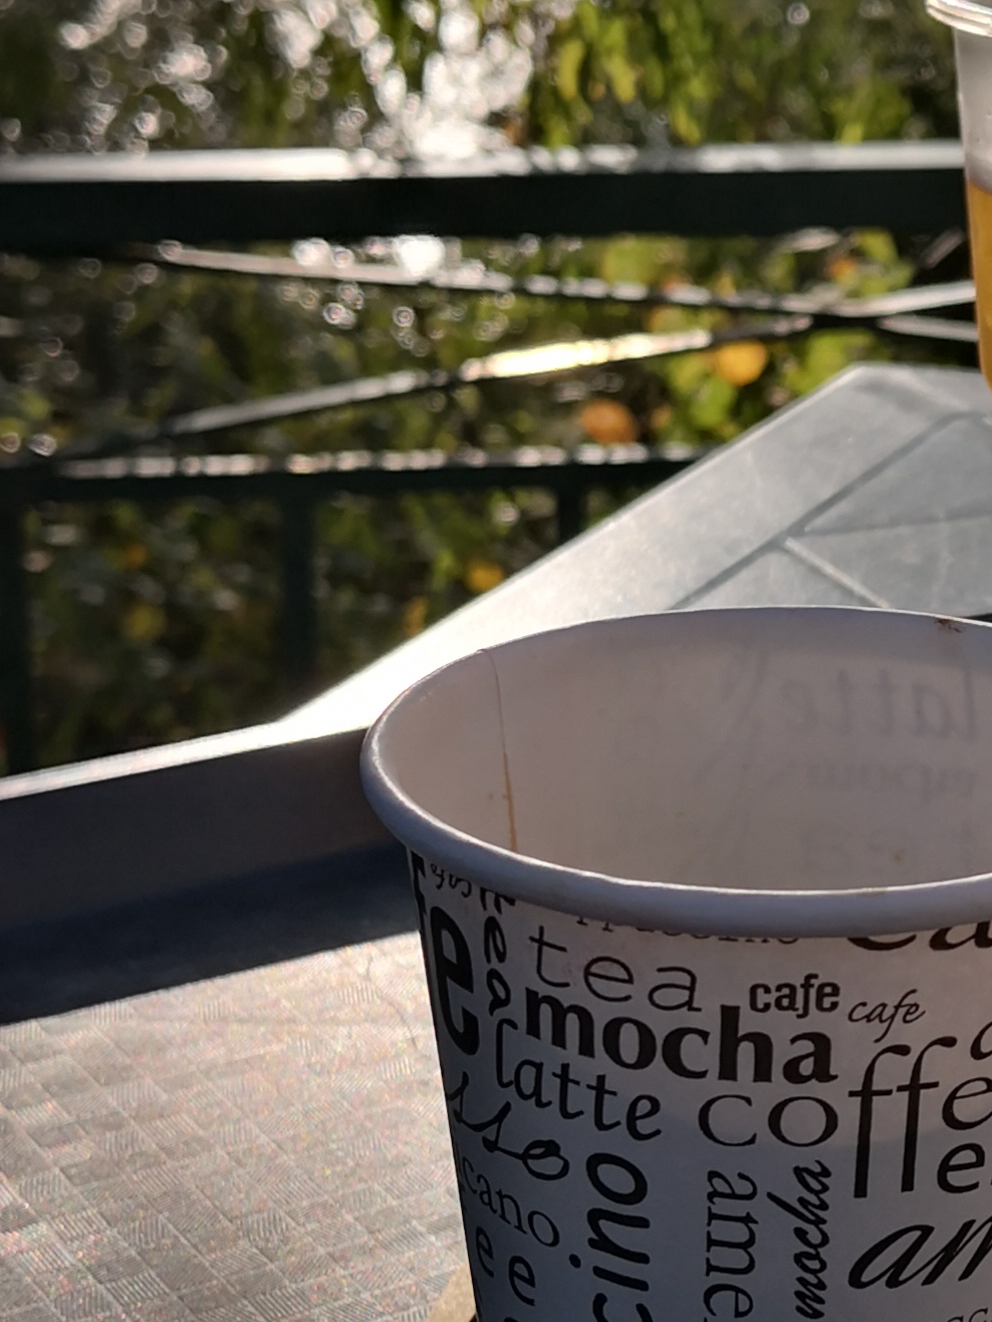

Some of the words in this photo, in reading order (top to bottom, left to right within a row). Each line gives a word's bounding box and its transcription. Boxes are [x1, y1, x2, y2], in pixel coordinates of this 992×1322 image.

[528, 925, 702, 1012] tea
[749, 972, 841, 1019] cafe
[525, 986, 839, 1085] mocha
[847, 988, 927, 1044] cafe
[495, 1018, 662, 1141] latte
[766, 1158, 832, 1320] mocha
